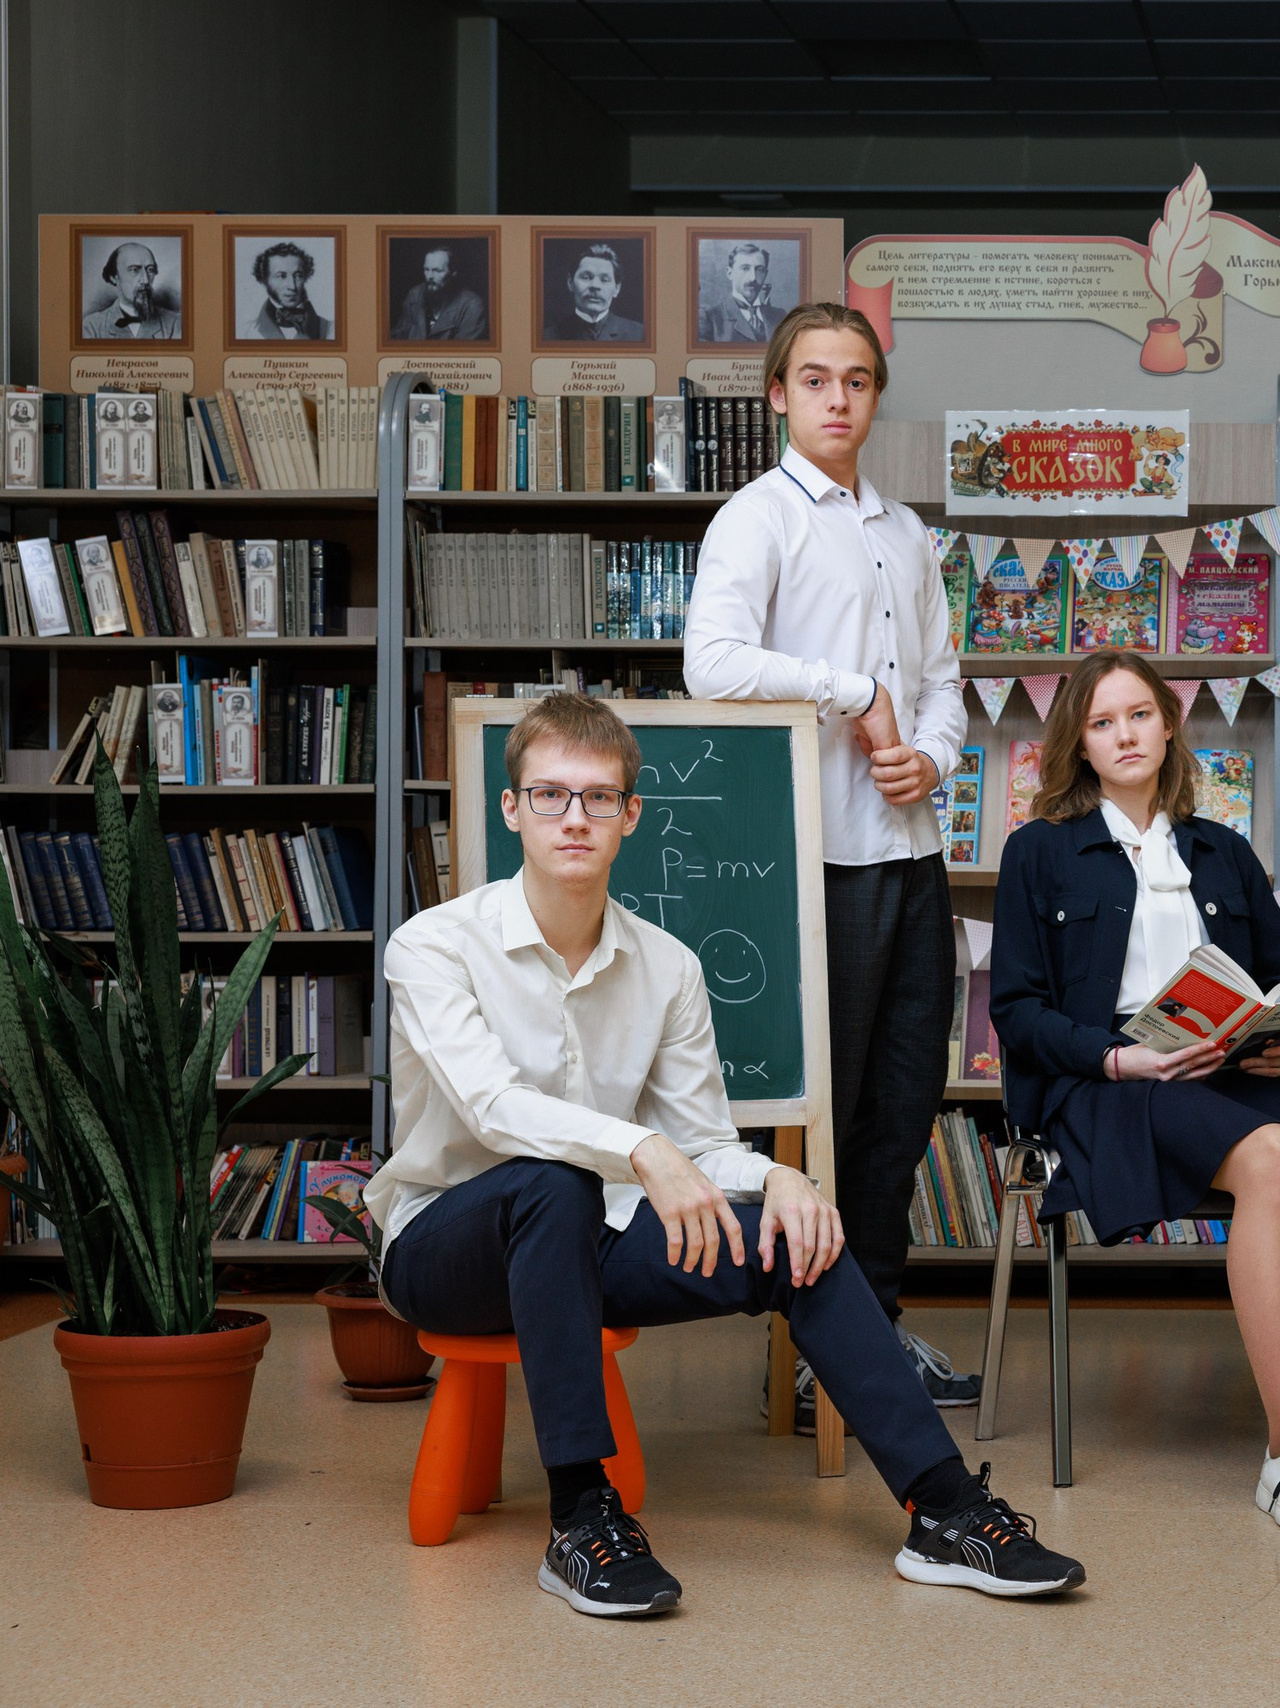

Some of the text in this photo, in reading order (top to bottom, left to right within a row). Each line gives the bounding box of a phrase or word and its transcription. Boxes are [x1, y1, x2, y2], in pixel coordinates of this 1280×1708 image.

[878, 250, 904, 261] Цель
[908, 253, 970, 261] литературы
[982, 253, 1029, 261] помогать
[1034, 253, 1078, 263] человеку
[866, 264, 899, 272] самого
[933, 264, 975, 273] поднять
[979, 264, 995, 272] его
[998, 265, 1021, 274] веру
[1072, 265, 1114, 274] развить
[931, 277, 991, 285] стремление
[1047, 277, 1093, 285] бороться
[1006, 289, 1038, 299] уметь
[1042, 288, 1073, 296] найти
[1077, 289, 1118, 299] хорошее
[898, 301, 960, 310] возбуждать
[974, 301, 985, 310] их
[989, 301, 1022, 310] душах
[106, 359, 159, 368] Некрасов
[263, 360, 309, 370] Пушкин
[401, 360, 476, 370] Достоевский
[570, 361, 617, 371] Горький
[76, 369, 189, 379] Николай Алексеевич
[228, 370, 343, 381] Александр Сергеевич
[571, 372, 616, 381] Максим
[702, 373, 731, 381] Иван
[562, 383, 625, 393] (1868-1936)
[1012, 438, 1123, 453] В МИРЕ МНОГО
[1012, 454, 1124, 484] СКАЗОК
[594, 556, 603, 600] ТОЛСТОЙ
